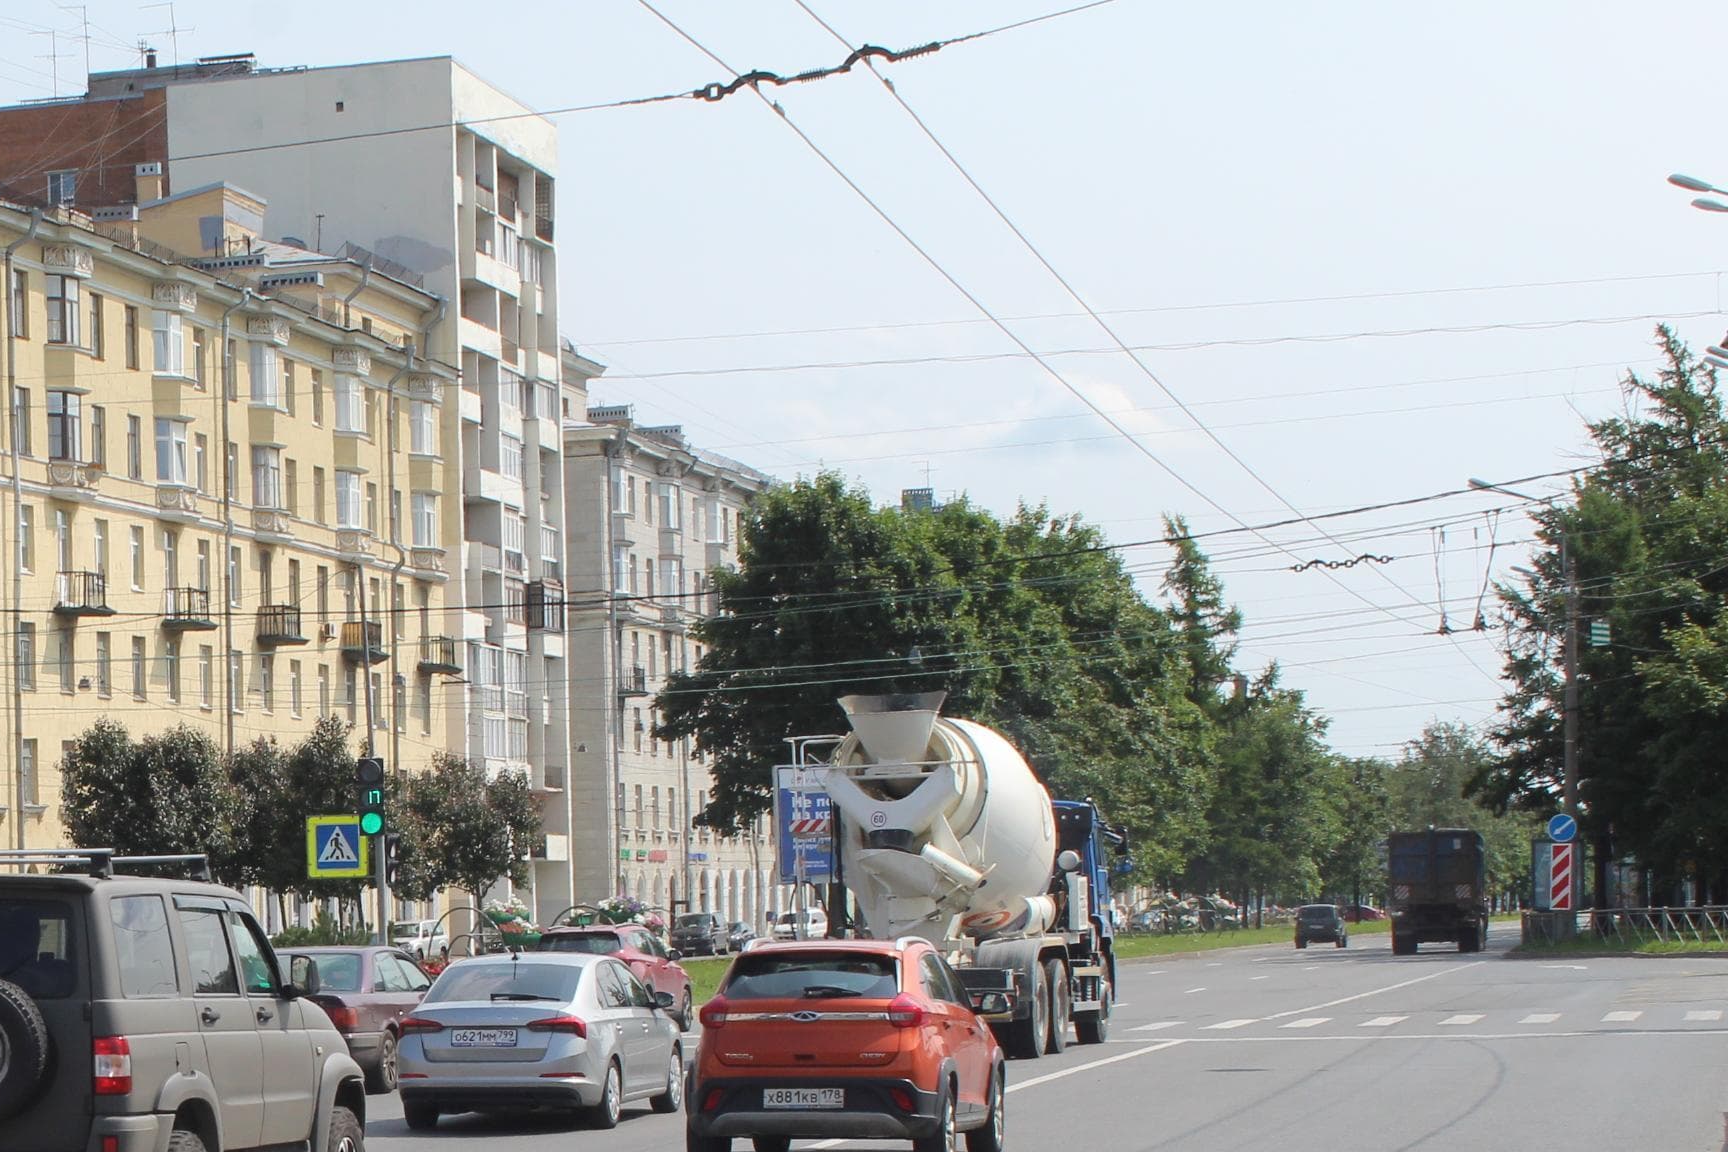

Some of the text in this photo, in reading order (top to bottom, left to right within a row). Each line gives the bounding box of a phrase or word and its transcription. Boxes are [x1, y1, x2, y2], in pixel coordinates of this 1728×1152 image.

[368, 790, 381, 804] 17
[873, 814, 884, 824] 60
[822, 1090, 840, 1099] 178
